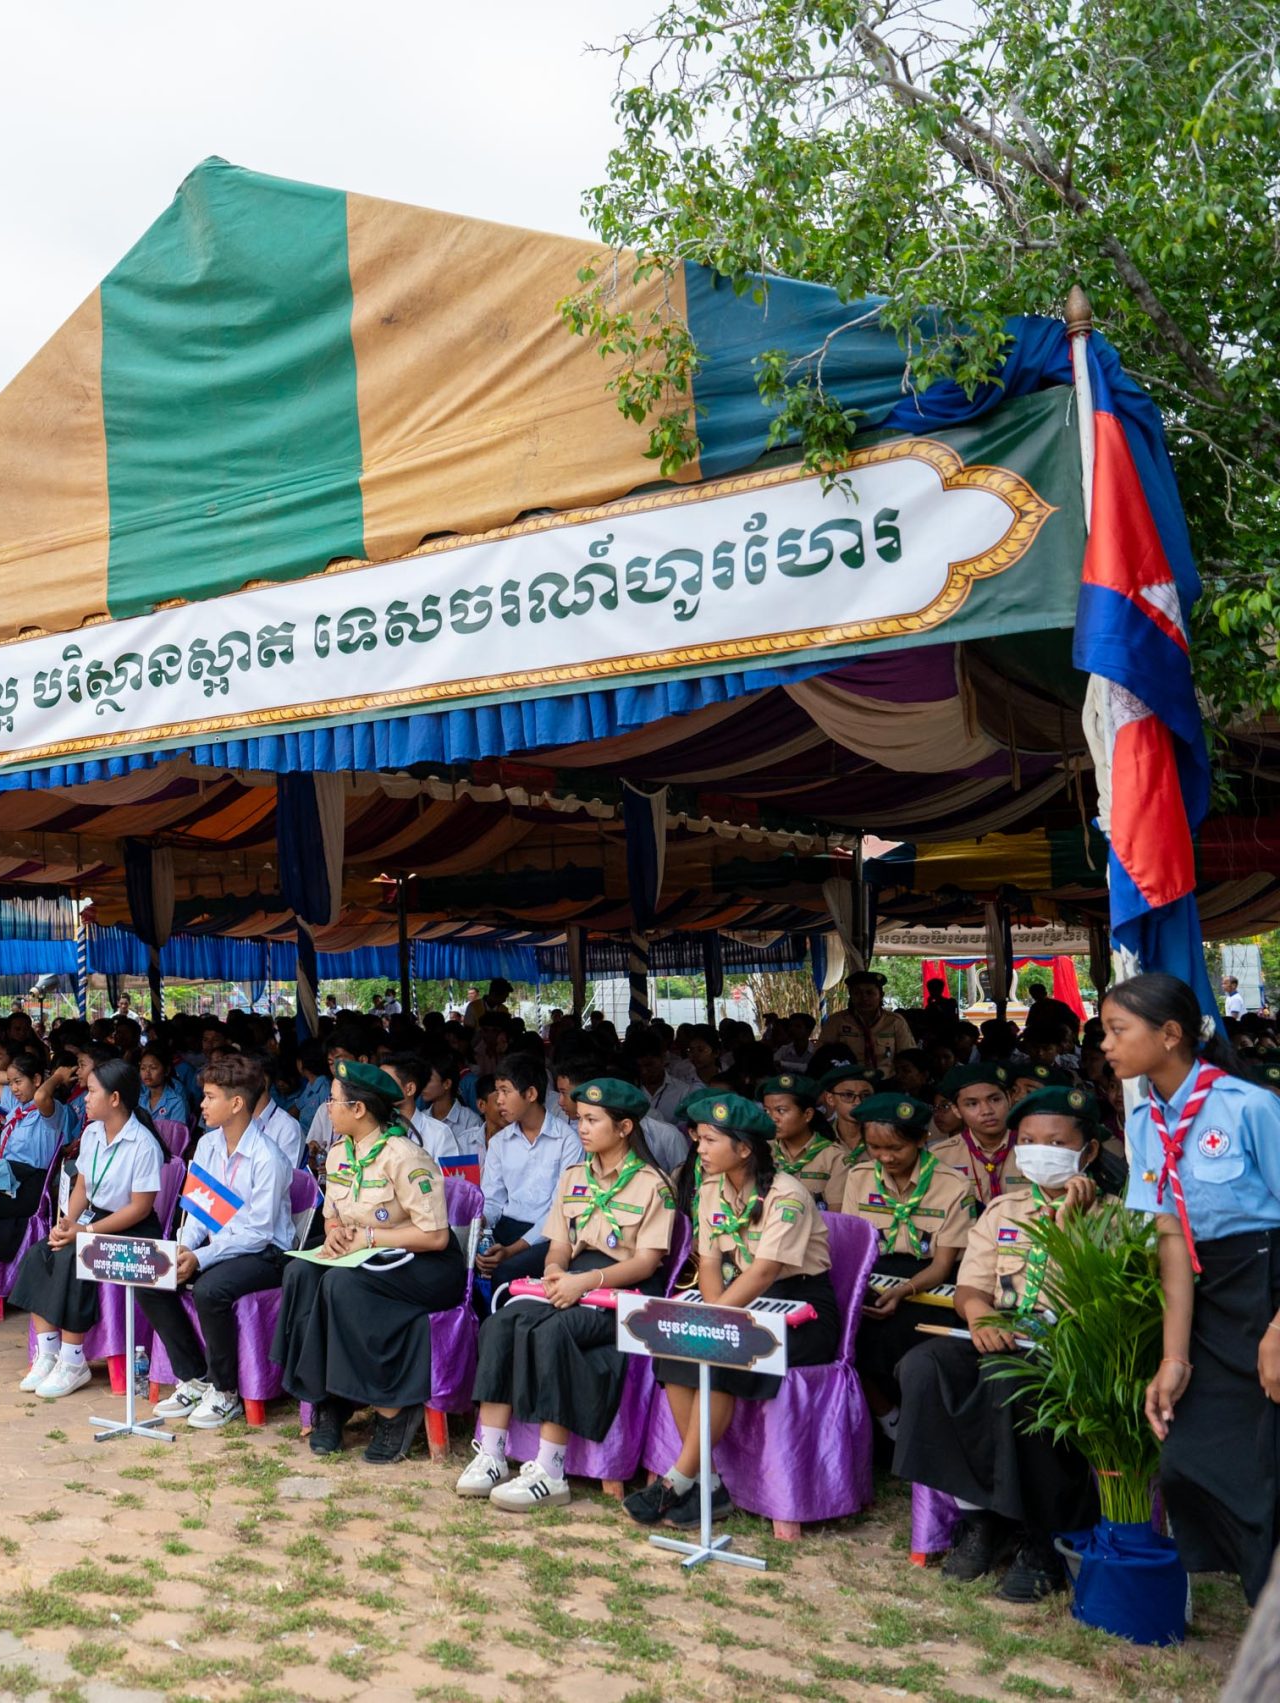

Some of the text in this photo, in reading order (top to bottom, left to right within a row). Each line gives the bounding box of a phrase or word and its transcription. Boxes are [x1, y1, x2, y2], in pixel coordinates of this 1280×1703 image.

[32, 621, 295, 714] បរិស្ថានស្អាត
